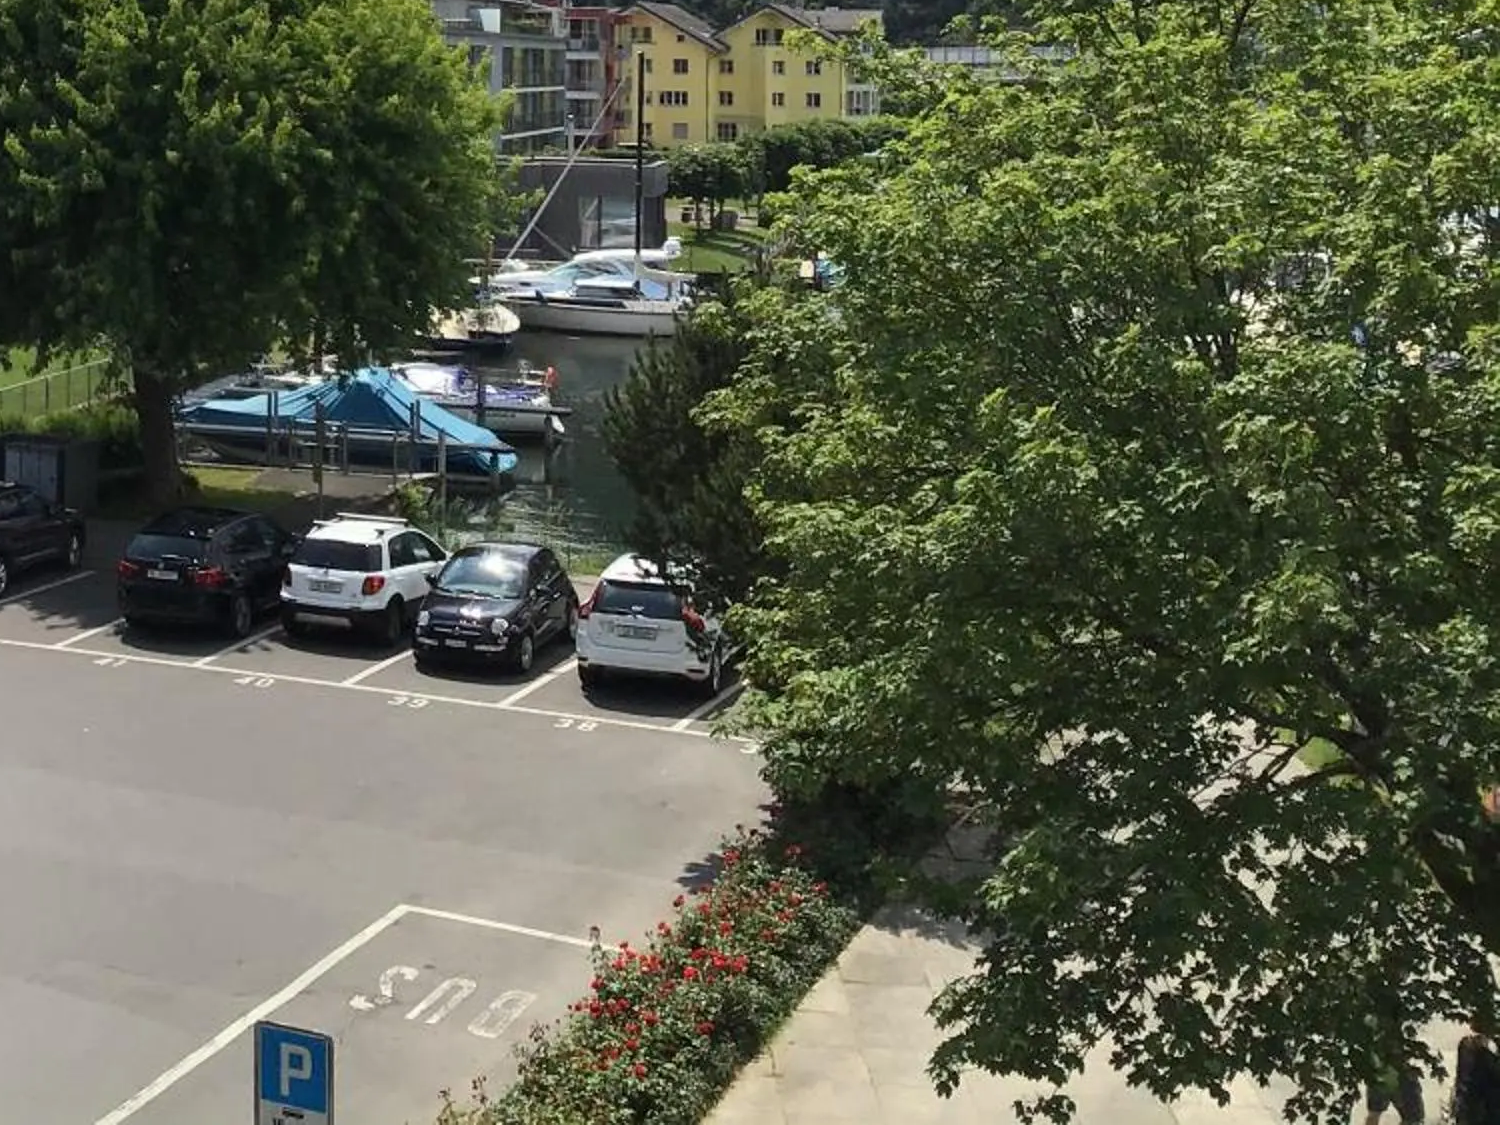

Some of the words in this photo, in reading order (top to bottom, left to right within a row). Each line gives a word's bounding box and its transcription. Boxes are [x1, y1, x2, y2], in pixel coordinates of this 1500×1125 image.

[232, 676, 275, 689] 40
[387, 695, 430, 709] 39
[553, 718, 599, 733] 38
[349, 965, 539, 1040] BUS
[280, 1041, 313, 1097] P
